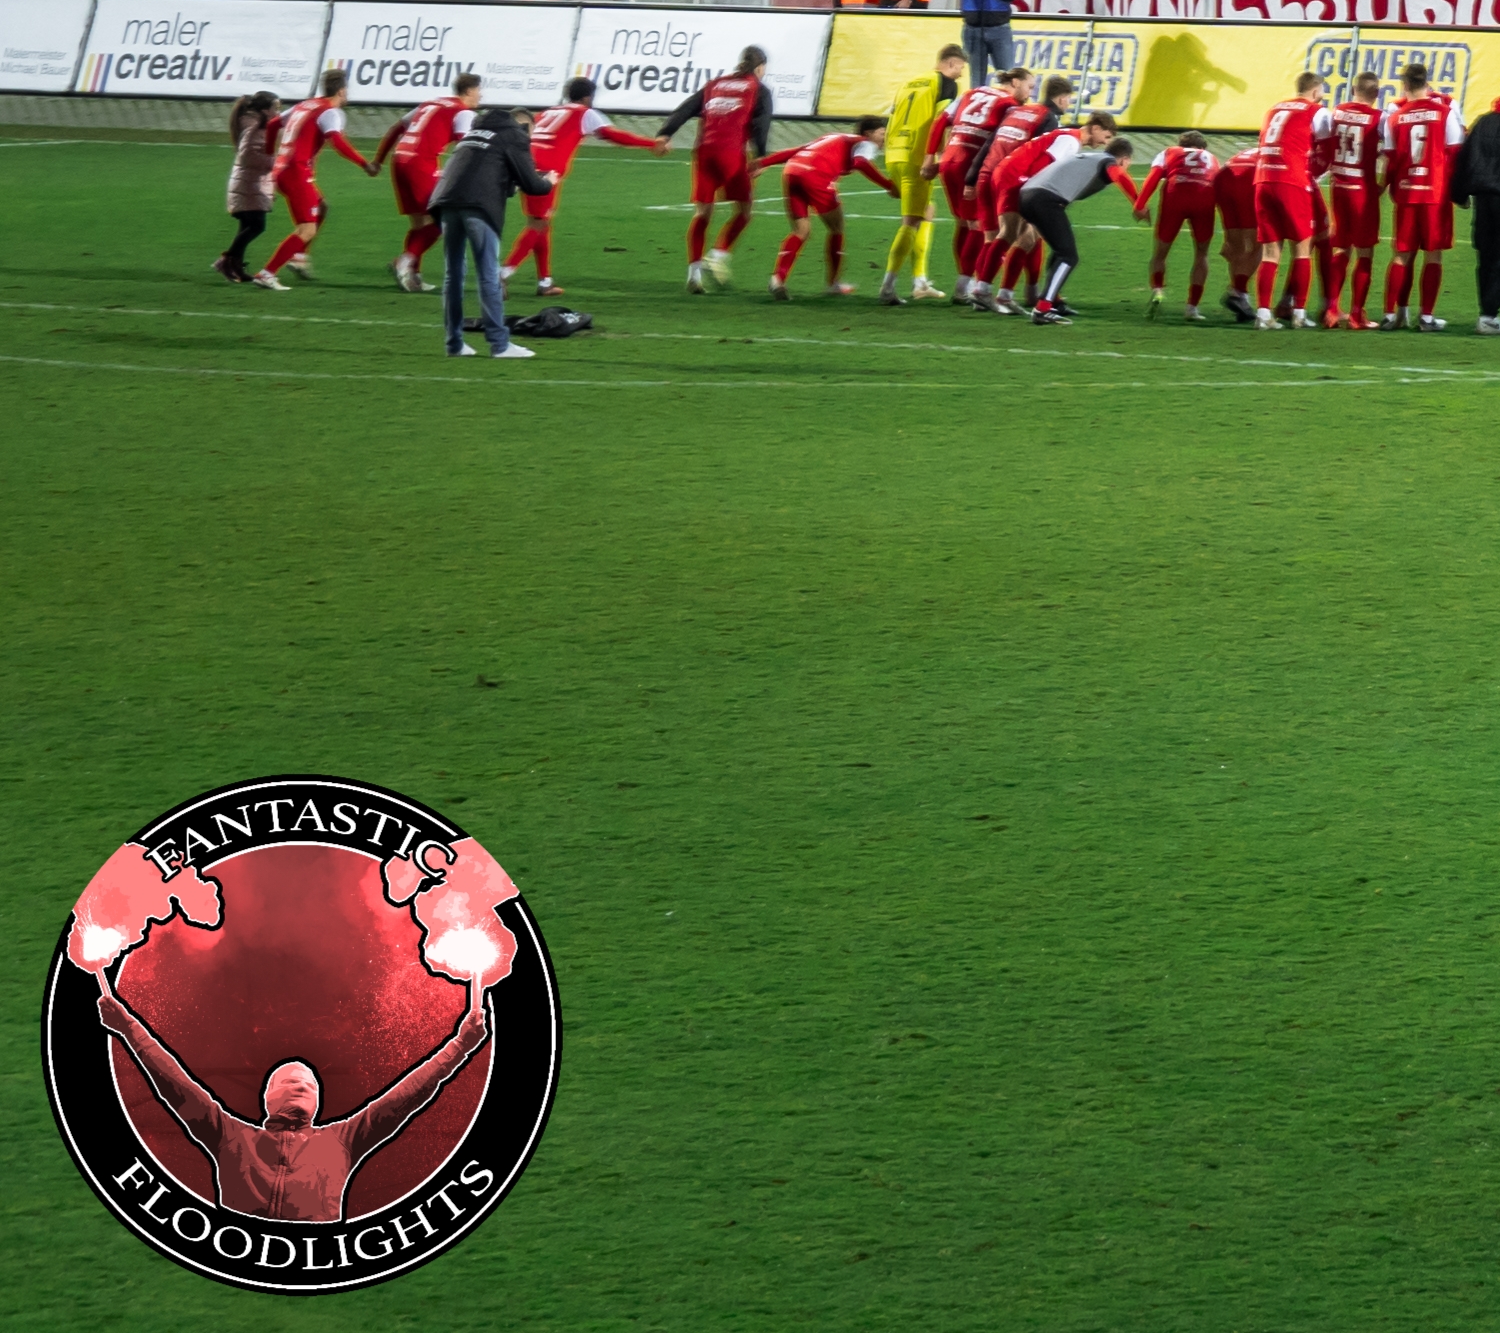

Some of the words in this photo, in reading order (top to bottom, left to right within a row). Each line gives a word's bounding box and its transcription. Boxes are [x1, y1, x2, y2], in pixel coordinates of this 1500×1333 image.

[121, 12, 211, 47] maler
[361, 16, 452, 54] maler
[610, 22, 703, 58] maler
[1013, 39, 1125, 72] OMEDIA
[1333, 123, 1365, 166] 33
